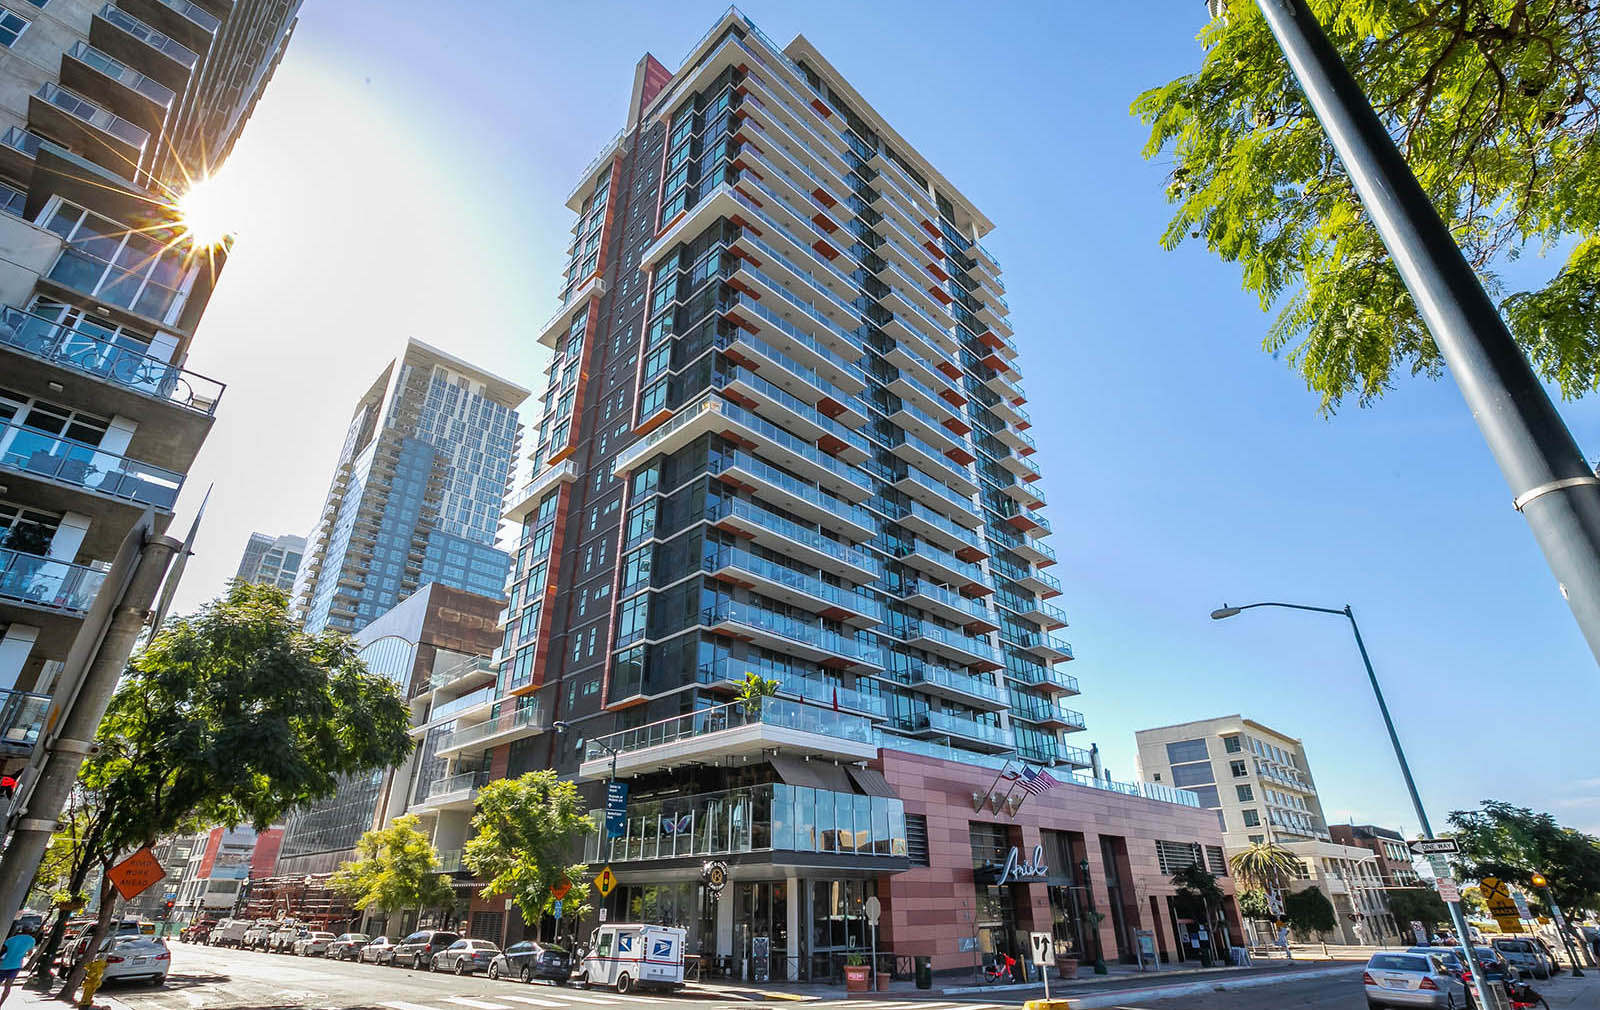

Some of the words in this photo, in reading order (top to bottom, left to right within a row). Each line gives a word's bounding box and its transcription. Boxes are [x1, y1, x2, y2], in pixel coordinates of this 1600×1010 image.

[1437, 842, 1452, 850] WAY
[130, 860, 153, 868] ROAD
[997, 845, 1048, 886] Ariel
[120, 879, 148, 887] AHEAD
